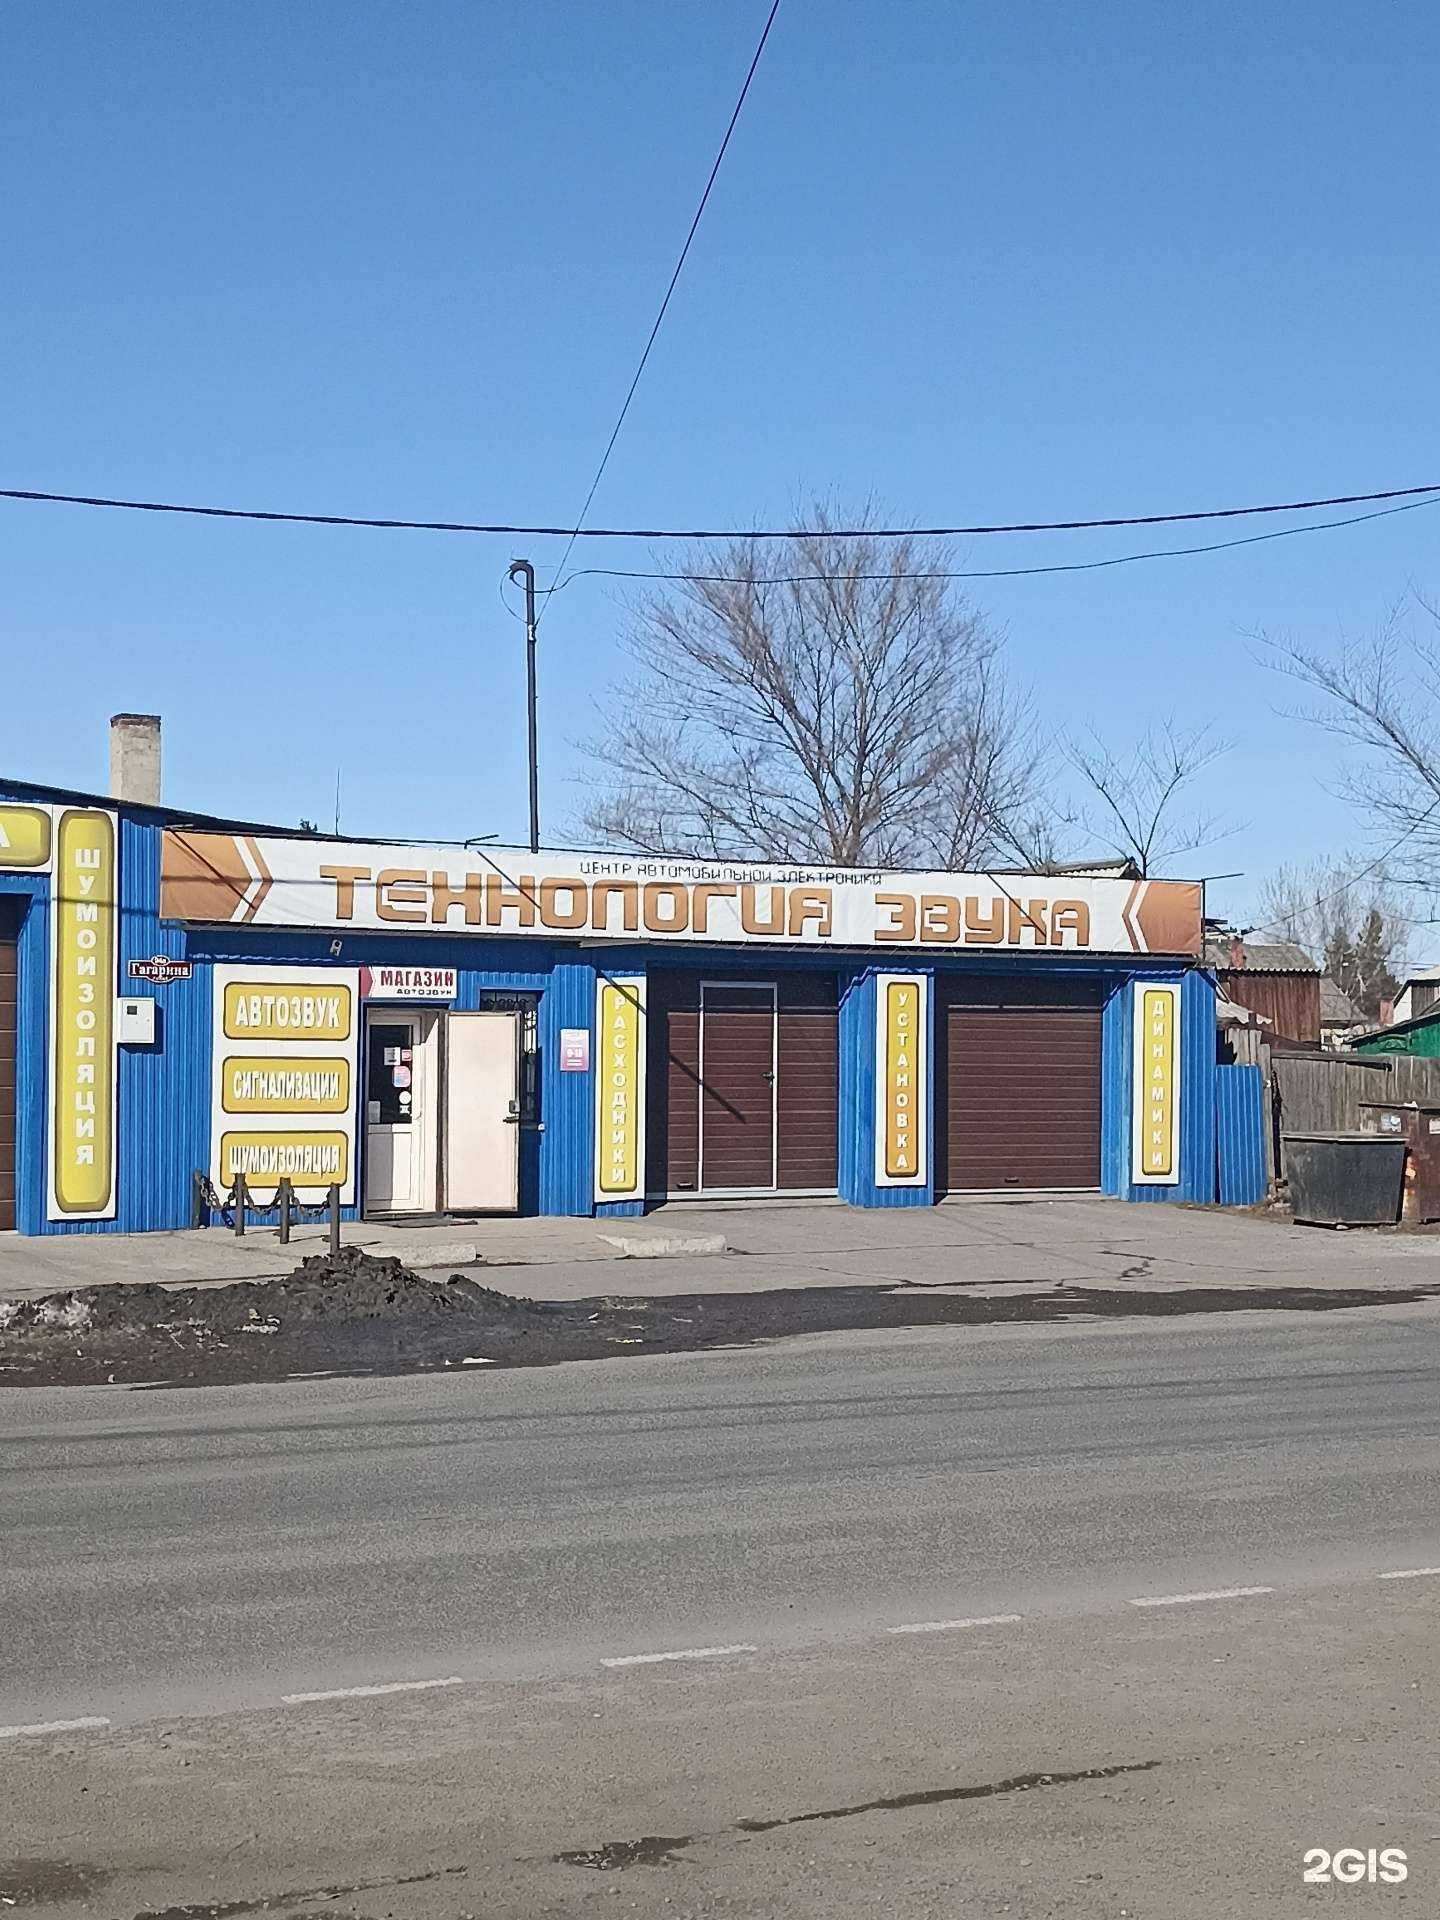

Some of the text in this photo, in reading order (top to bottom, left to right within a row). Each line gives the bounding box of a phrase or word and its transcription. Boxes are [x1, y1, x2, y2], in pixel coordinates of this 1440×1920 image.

[580, 861, 882, 886] ЦЕНТР АВТОМОБИЛЬНОЙ ЭЛЕКТРОНИКИ
[319, 865, 1090, 947] ТЕХНОЛОГИЯ ЗВУКА
[131, 962, 189, 978] Гагарина
[380, 970, 454, 987] МАГАЗИН
[75, 848, 100, 1166] ШУМОИЗОЛЯЦИЯ
[235, 995, 340, 1028] АВТОЗВУК
[232, 1070, 340, 1104] СИГНАЛИЗАЦИИ
[611, 994, 627, 1184] РАСХОДНИКИ
[896, 992, 909, 1169] УСТАНОВКА
[1152, 1000, 1165, 1167] ДИНАМИКИ
[229, 1144, 341, 1179] ШУМОИЗОЛЯЦИЯ
